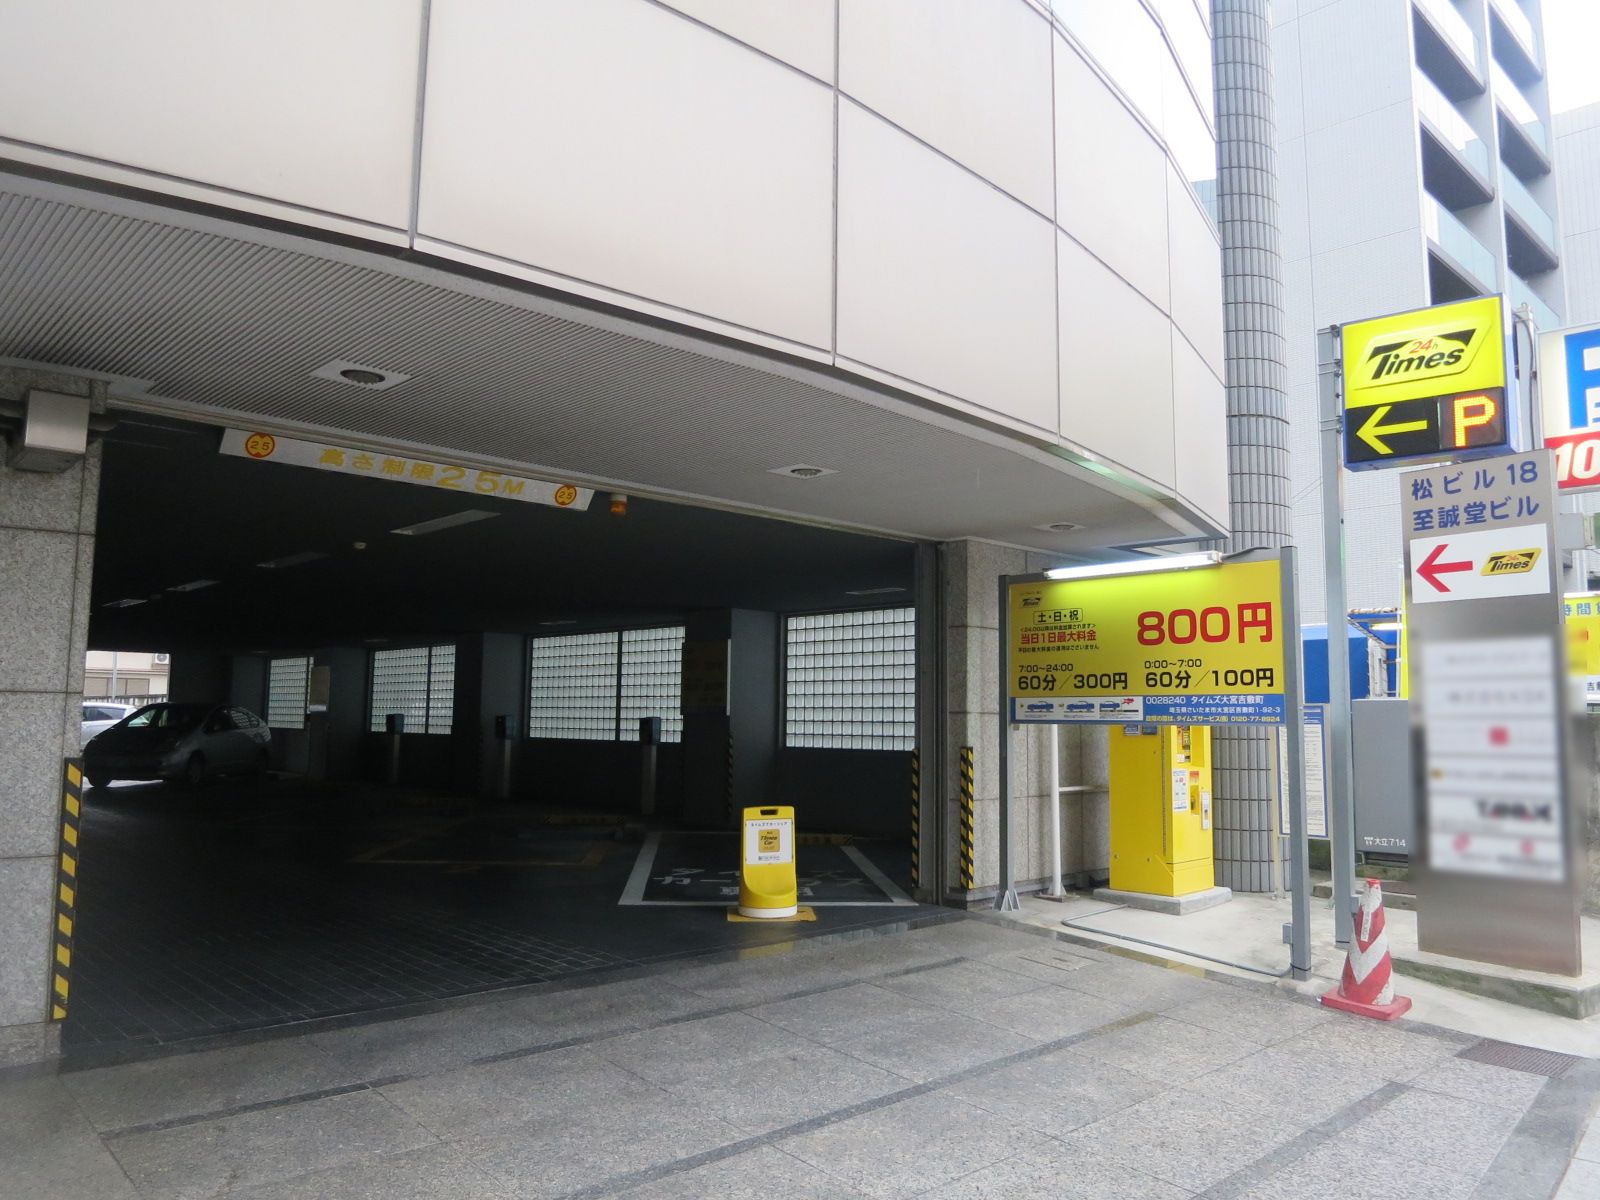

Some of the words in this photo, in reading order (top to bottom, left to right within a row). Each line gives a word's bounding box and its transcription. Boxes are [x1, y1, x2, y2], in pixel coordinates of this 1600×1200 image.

[1371, 348, 1465, 380] Times
[1453, 395, 1496, 448] P
[1413, 496, 1540, 531] 至誠堂ビル
[1490, 560, 1530, 572] Times
[1020, 630, 1097, 645] 当日1日最大料金
[1037, 610, 1079, 623] 土・日・祝
[1137, 601, 1273, 645] 800円
[1145, 696, 1186, 705] 0028240
